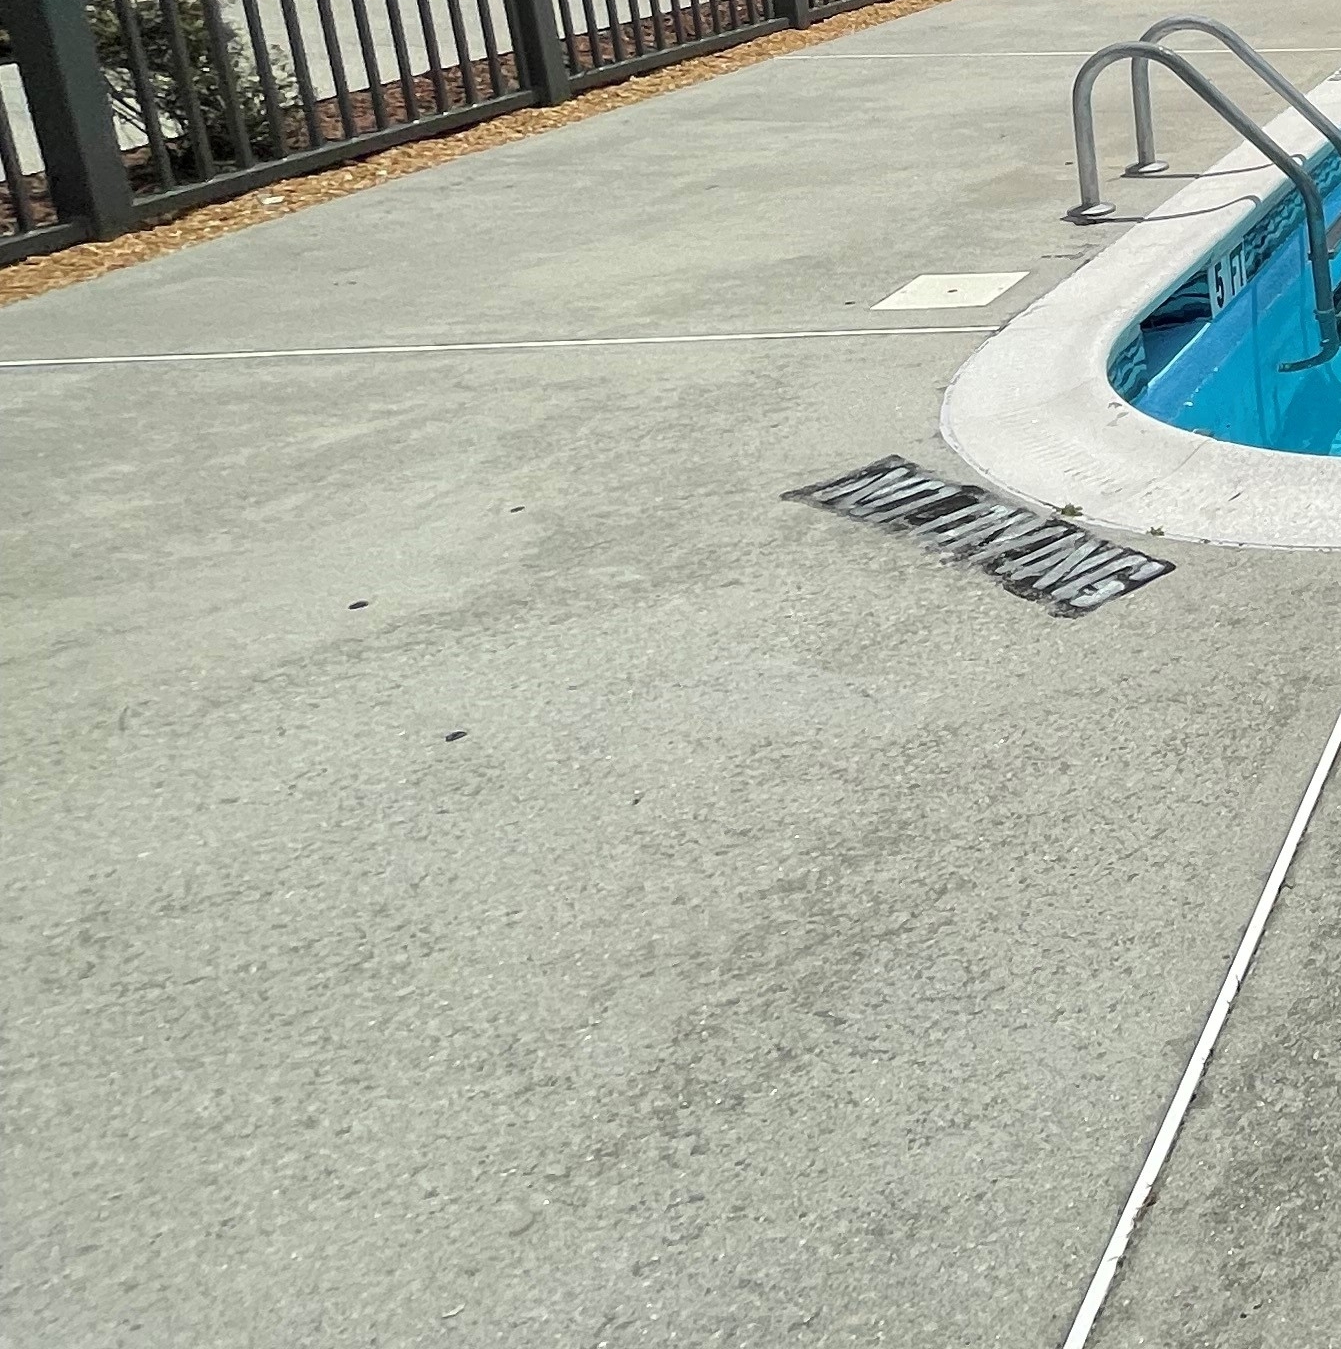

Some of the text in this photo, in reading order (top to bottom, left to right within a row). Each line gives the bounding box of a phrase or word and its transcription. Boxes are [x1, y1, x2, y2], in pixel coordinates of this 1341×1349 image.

[1214, 242, 1244, 309] 5 FT
[811, 465, 1168, 607] NO DIVING
